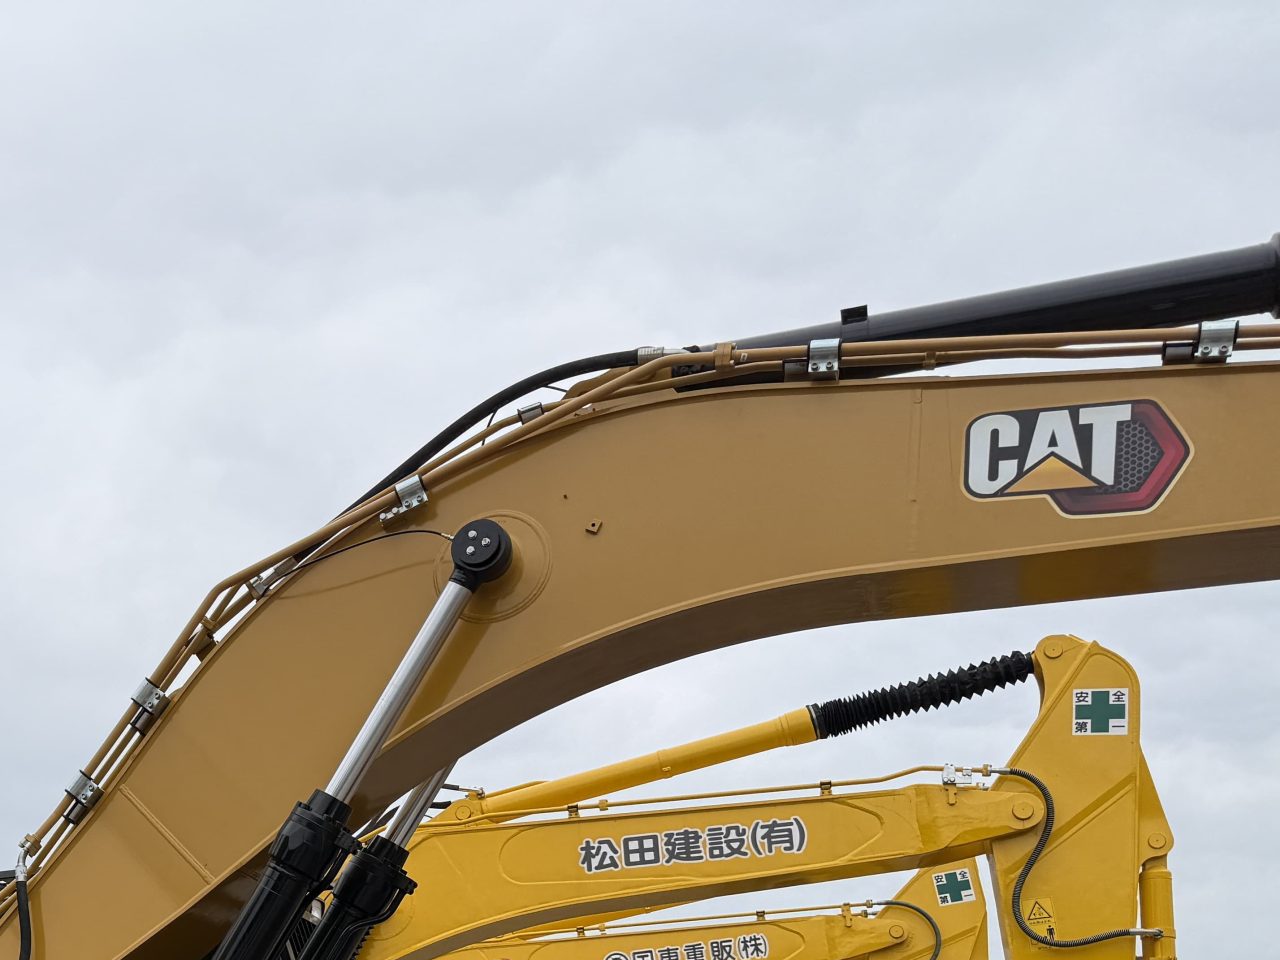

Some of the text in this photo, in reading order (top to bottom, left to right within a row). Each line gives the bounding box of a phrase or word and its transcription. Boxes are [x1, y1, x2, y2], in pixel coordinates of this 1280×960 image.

[968, 403, 1132, 495] CAT
[579, 817, 807, 872] 松田建設(有)
